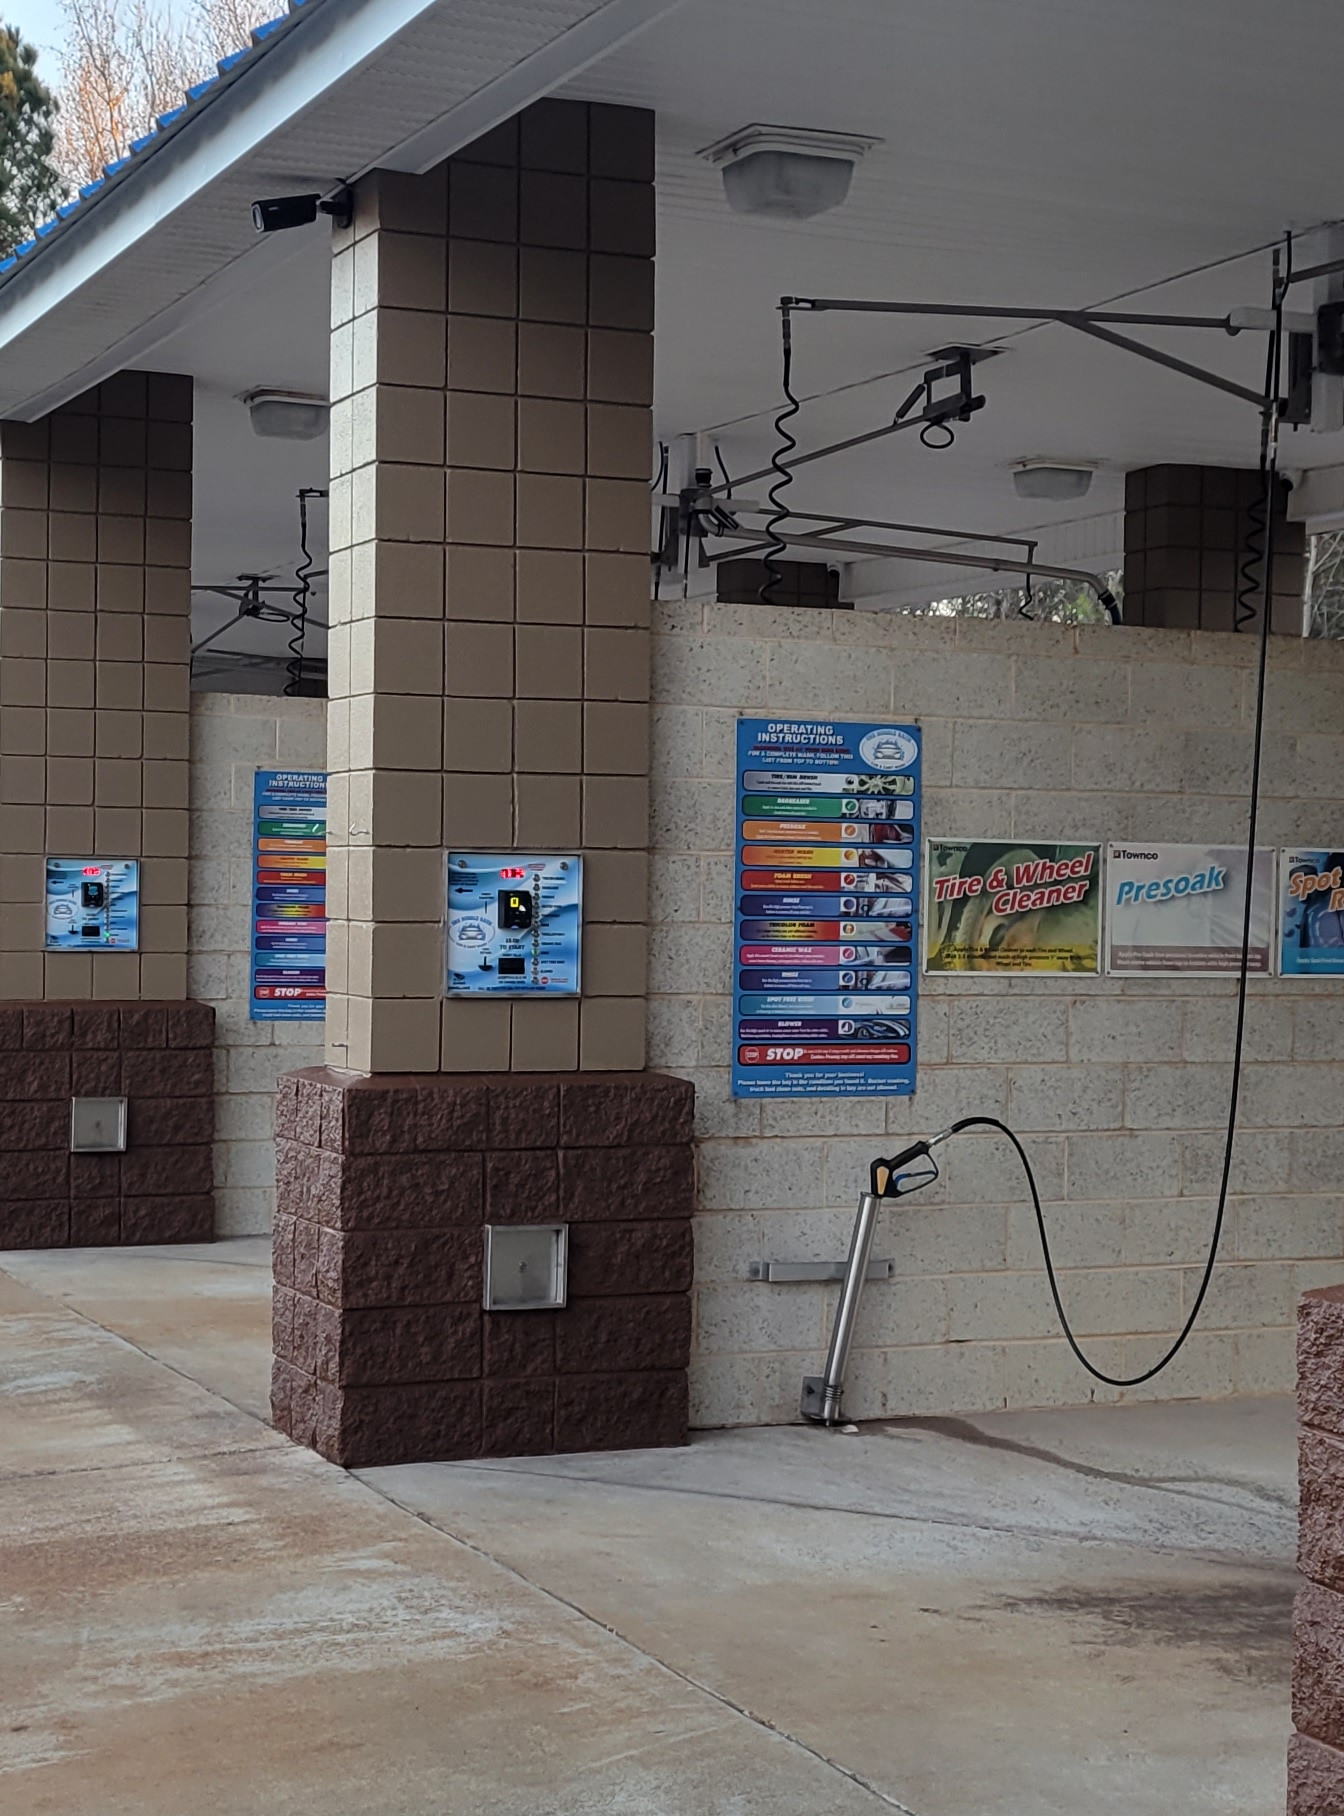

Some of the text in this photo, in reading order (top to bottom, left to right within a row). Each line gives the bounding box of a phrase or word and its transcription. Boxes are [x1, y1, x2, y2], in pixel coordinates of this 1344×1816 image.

[767, 723, 834, 735] OPERATING
[757, 732, 844, 745] INSTRUCTIONS
[268, 779, 325, 788] INSTRUCTION
[275, 773, 324, 782] OPERATING
[1121, 850, 1158, 860] Townco
[934, 851, 1094, 901] Tire & Wheel
[1115, 865, 1226, 907] Presoak
[1288, 866, 1343, 901] Spot
[992, 881, 1089, 916] Cleaner
[273, 987, 303, 997] STOP
[765, 1047, 804, 1061] STOP
